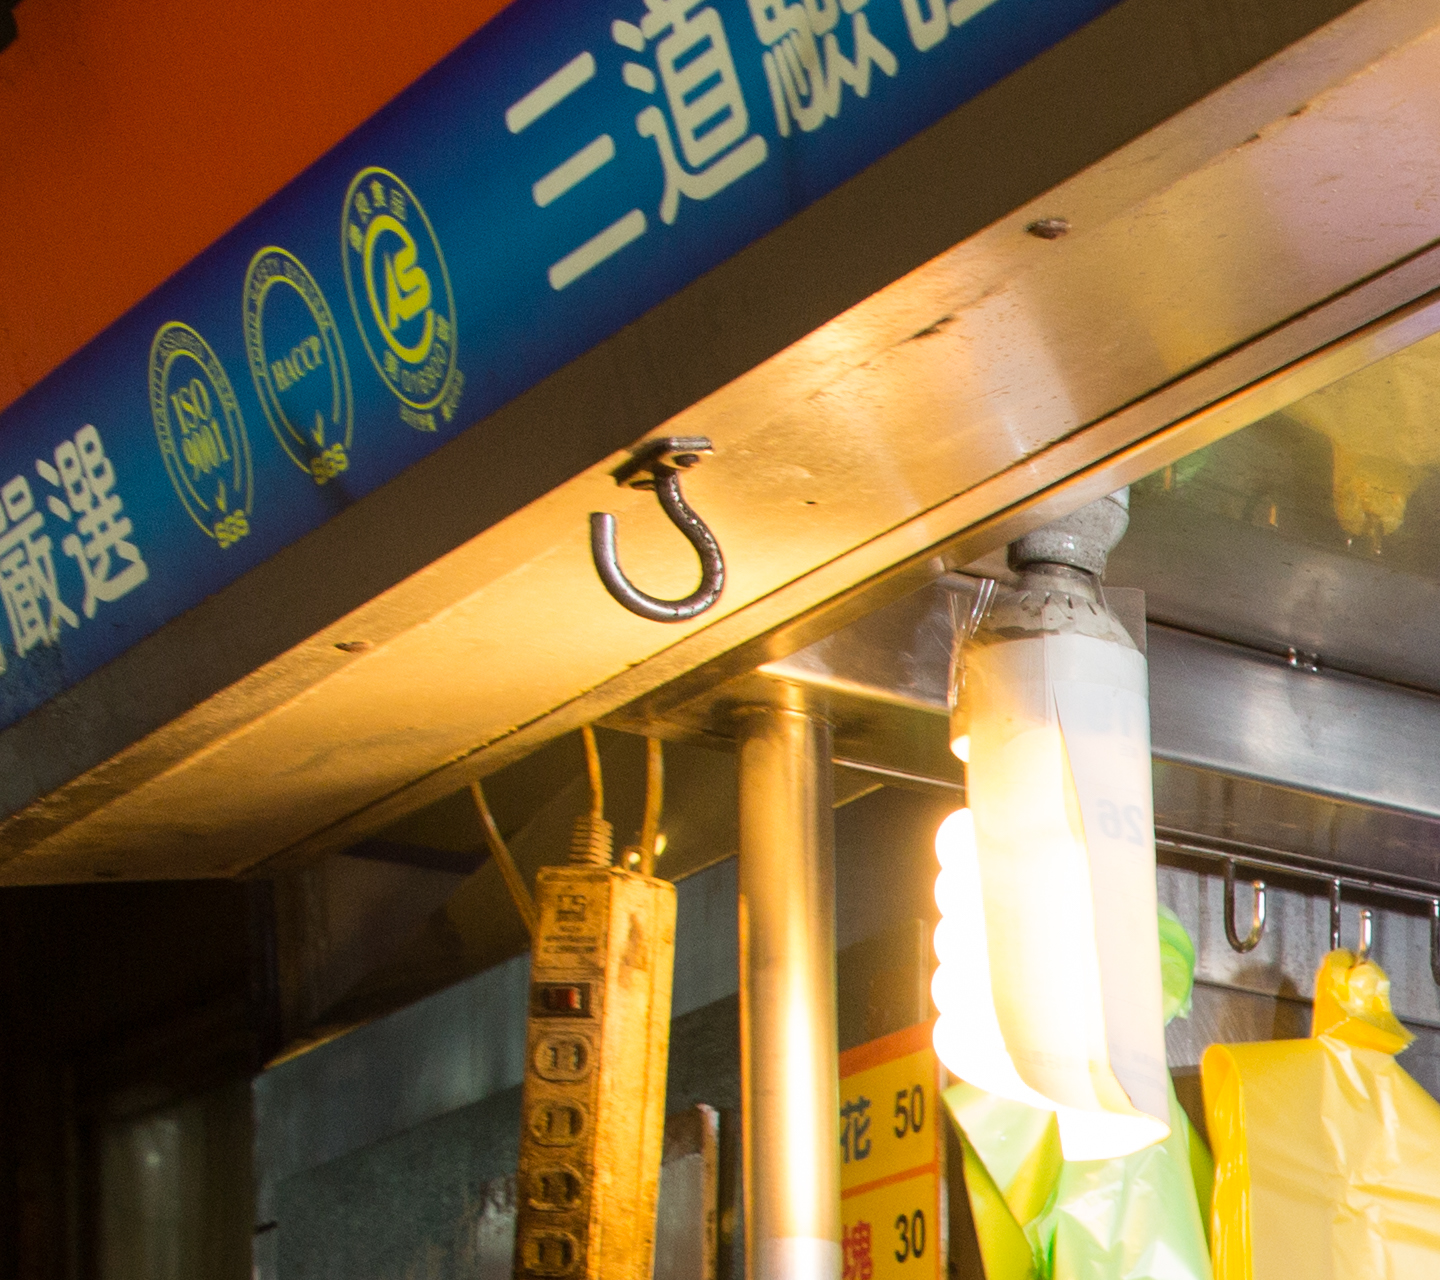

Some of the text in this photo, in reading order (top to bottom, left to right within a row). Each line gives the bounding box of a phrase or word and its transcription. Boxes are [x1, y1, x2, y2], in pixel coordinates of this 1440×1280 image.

[270, 335, 324, 392] HACCP
[310, 442, 349, 485] SGS
[894, 1083, 925, 1139] 50
[894, 1208, 926, 1264] 30
